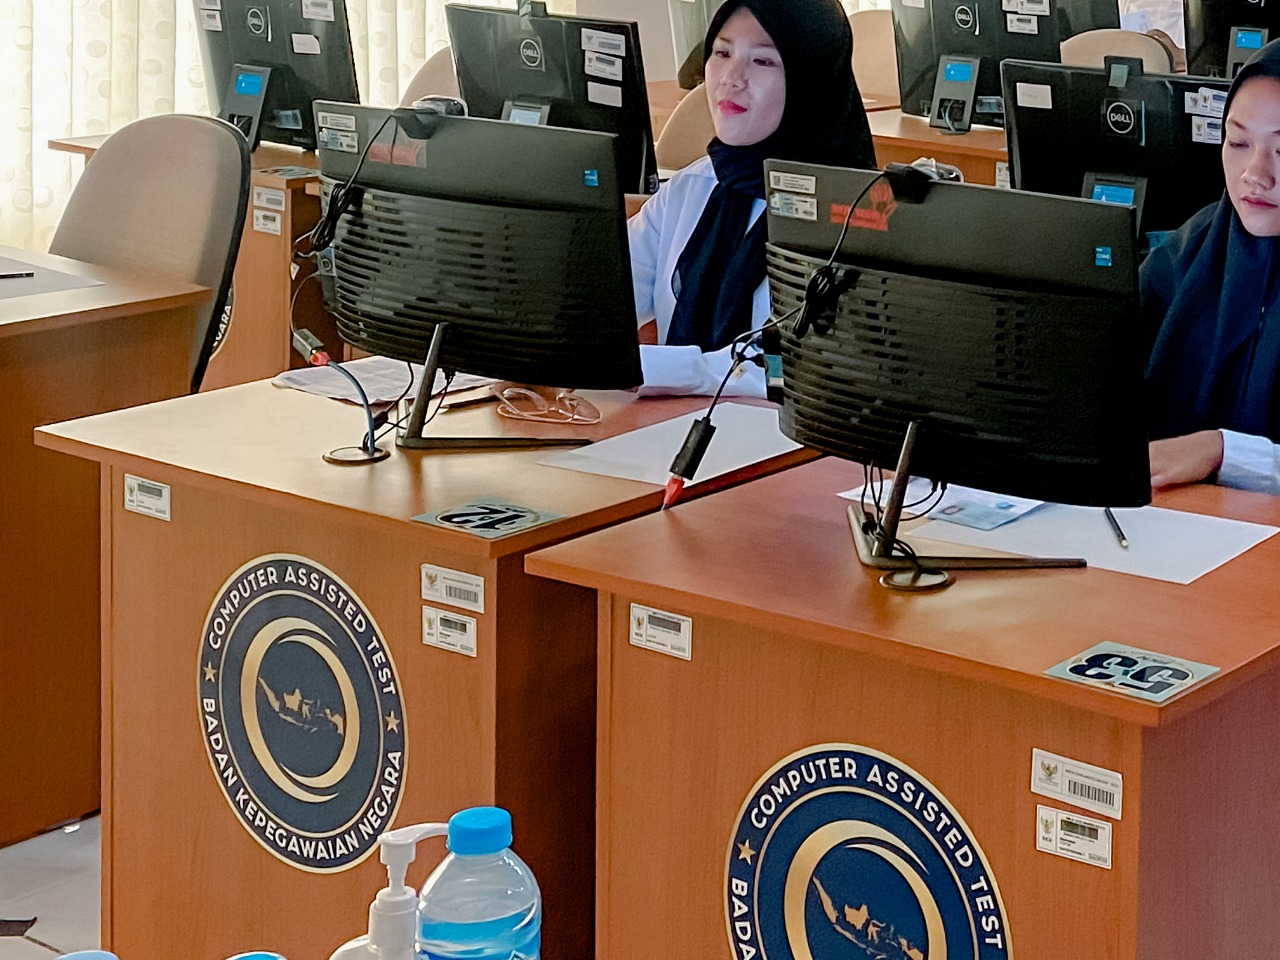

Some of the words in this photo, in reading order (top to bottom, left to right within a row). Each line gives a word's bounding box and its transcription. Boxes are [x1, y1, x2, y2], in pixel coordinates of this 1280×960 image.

[957, 13, 971, 21] DELL
[523, 49, 539, 58] DELL
[1110, 113, 1130, 123] DELL
[439, 506, 527, 530] 12
[209, 566, 278, 649] COMPUTER
[284, 566, 367, 633] ASSISTED
[366, 636, 396, 696] TEST
[1068, 653, 1191, 694] 53
[203, 697, 238, 787] BADAN
[235, 788, 360, 860] KEPEGAWAIAN
[359, 751, 402, 840] NEGARA
[751, 757, 857, 829] COMPUTER
[867, 764, 974, 868] ASSISTED
[970, 876, 1004, 949] TEST
[731, 877, 757, 960] BADA
